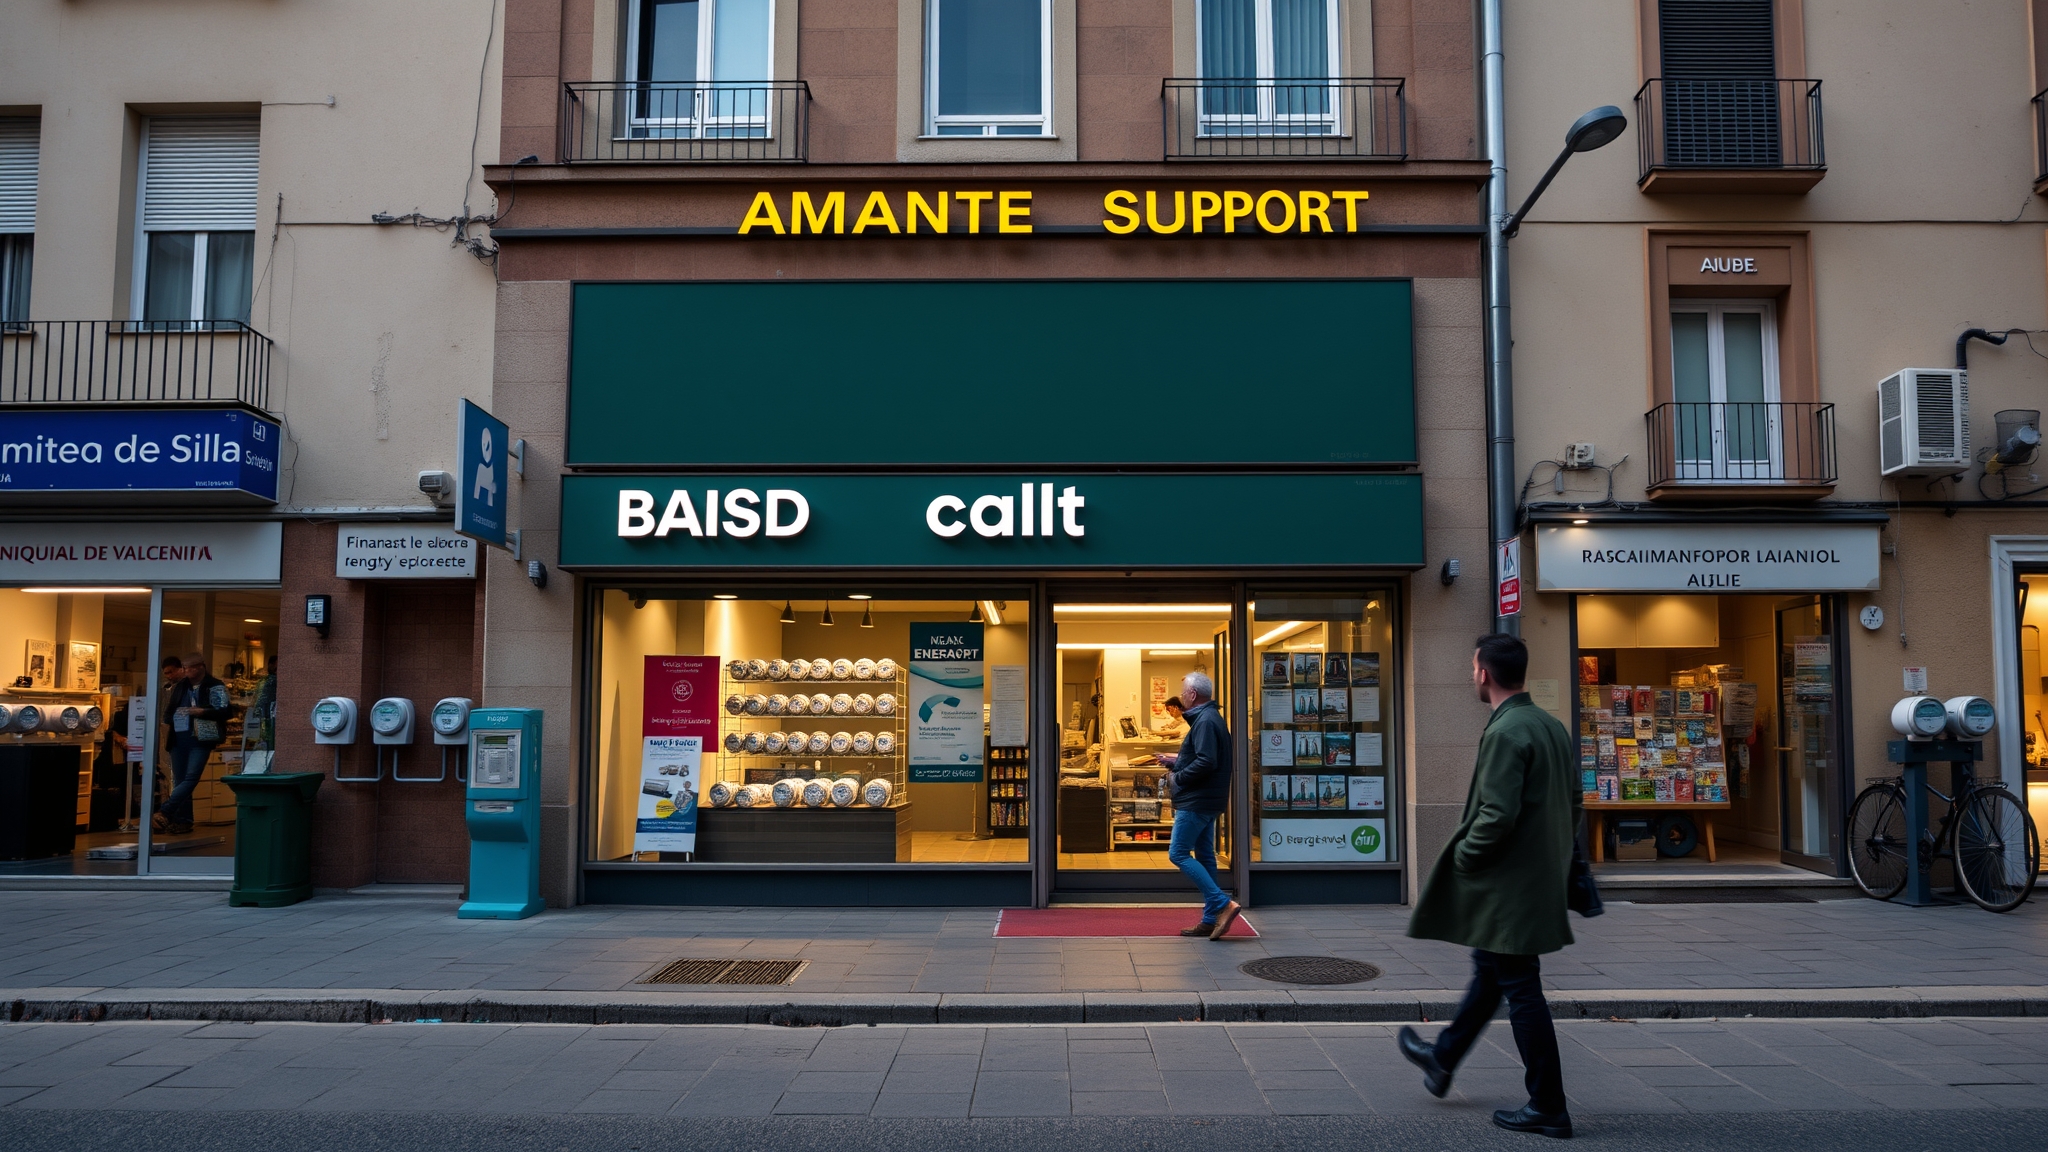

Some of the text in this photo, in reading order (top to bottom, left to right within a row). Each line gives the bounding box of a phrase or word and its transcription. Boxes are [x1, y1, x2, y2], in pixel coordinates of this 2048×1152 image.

[738, 189, 1370, 236] AMANTE SUPPORT
[114, 434, 160, 464] de
[170, 433, 241, 464] Silla
[616, 482, 1086, 539] BAISD callt
[84, 545, 108, 561] DE
[410, 536, 423, 548] le
